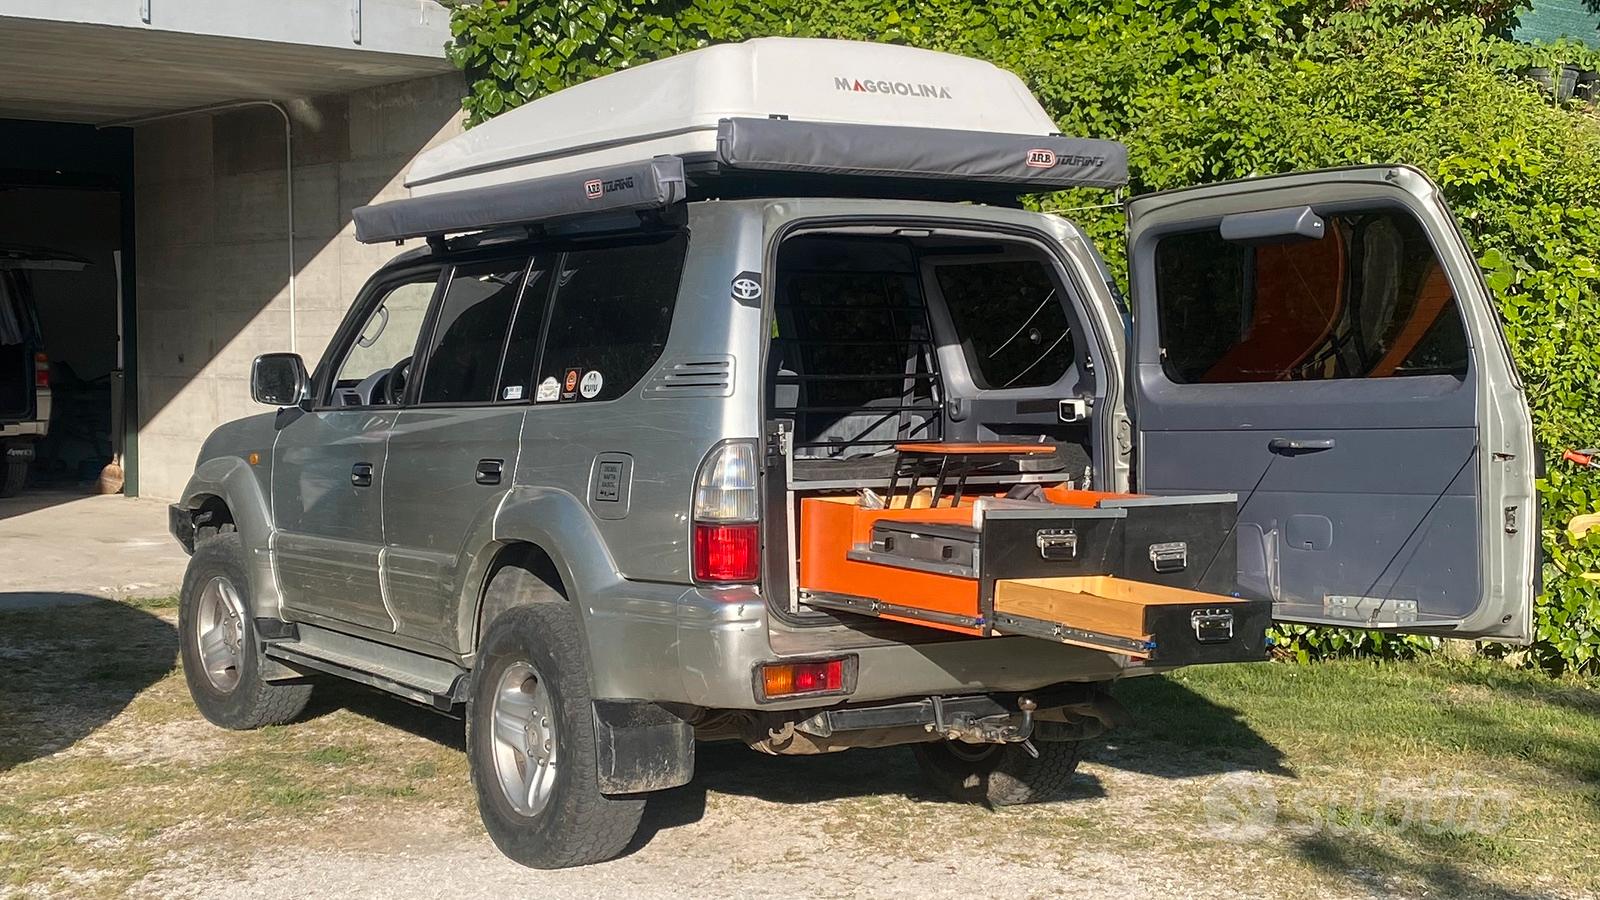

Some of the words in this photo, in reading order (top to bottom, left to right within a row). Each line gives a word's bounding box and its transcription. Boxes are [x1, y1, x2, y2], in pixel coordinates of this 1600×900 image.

[834, 77, 952, 99] MAGGIOLINA
[1030, 153, 1052, 163] ARB
[1055, 154, 1104, 167] TOURING
[602, 177, 634, 192] TOURING
